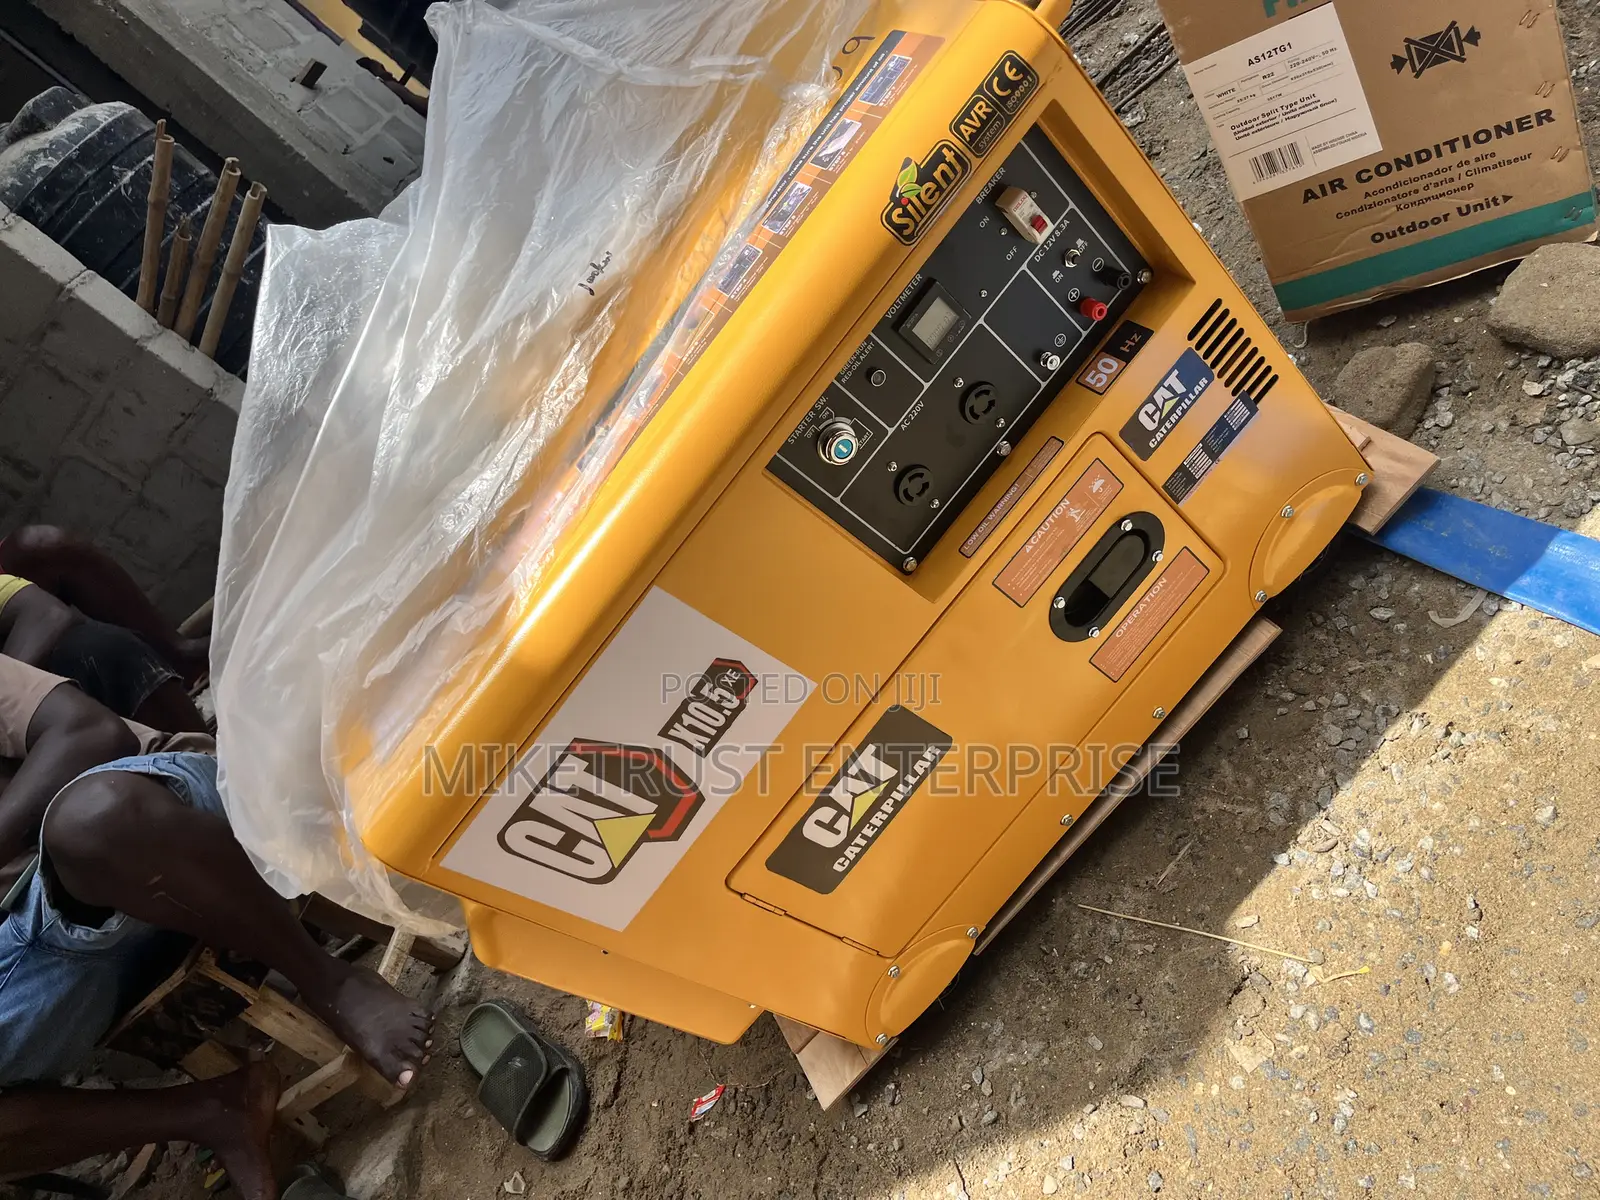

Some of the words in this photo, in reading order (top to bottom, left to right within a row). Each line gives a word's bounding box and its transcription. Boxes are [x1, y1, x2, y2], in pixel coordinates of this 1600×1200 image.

[1247, 42, 1293, 66] AS12TG1
[992, 61, 1023, 97] CE
[1216, 88, 1236, 99] WHITE
[1262, 72, 1275, 80] R22
[879, 90, 892, 106] STEP
[1230, 116, 1260, 131] Outdoor
[1261, 108, 1278, 119] Split
[1280, 100, 1298, 113] Type
[1299, 93, 1316, 103] Unit
[789, 160, 802, 176] make
[802, 146, 814, 160] sure
[812, 135, 822, 145] the
[830, 112, 840, 123] has
[839, 91, 855, 112] proper
[855, 68, 874, 91] amount
[959, 100, 993, 142] AVR
[978, 120, 1001, 150] system
[829, 156, 841, 171] STEP
[1302, 176, 1348, 204] AIR
[1355, 108, 1556, 184] CONDITIONER
[1363, 164, 1453, 199] Acondicionador
[1457, 158, 1471, 168] de
[1473, 150, 1496, 164] aire
[891, 148, 963, 236] Silent
[976, 167, 1006, 205] BREAKER
[1335, 187, 1420, 220] Condizionatore
[1422, 177, 1454, 192] d'aria
[1457, 172, 1461, 181] /
[1465, 152, 1533, 178] Climatiseur
[1395, 181, 1474, 212] Кондиционер
[779, 220, 792, 235] STEP
[979, 216, 990, 229] ON
[1370, 212, 1451, 244] Outdoor
[1455, 195, 1501, 217] Unit
[1006, 246, 1019, 261] OFF
[1034, 247, 1046, 263] DC
[1044, 235, 1056, 252] 12V
[1055, 219, 1070, 238] 8.3A
[1078, 240, 1089, 254] OFF
[730, 284, 743, 299] STEP
[885, 273, 923, 320] VOLTMETER
[1054, 272, 1064, 283] ON
[839, 341, 868, 376] GREEN-RUN
[841, 361, 860, 384] RED-OIL
[859, 341, 876, 364] ALERT
[1085, 357, 1119, 387] 50
[1120, 331, 1142, 352] Hz
[821, 410, 830, 420] ON
[900, 419, 910, 431] AC
[909, 400, 925, 419] 220V
[1138, 369, 1187, 431] CAT
[1149, 377, 1208, 449] CATERPILLAR
[788, 411, 816, 445] STARTER
[814, 395, 829, 411] SW.
[806, 428, 816, 440] OFF
[857, 431, 871, 448] START
[964, 534, 978, 550] LOW
[977, 520, 989, 536] OIL
[1030, 499, 1070, 545] CAUTION
[1115, 577, 1168, 638] OPERATION
[668, 682, 740, 752] X10.5
[724, 668, 741, 688] XE
[802, 743, 898, 848] CAT
[832, 744, 942, 873] CATERPILLAR
[504, 753, 658, 880] CAT
